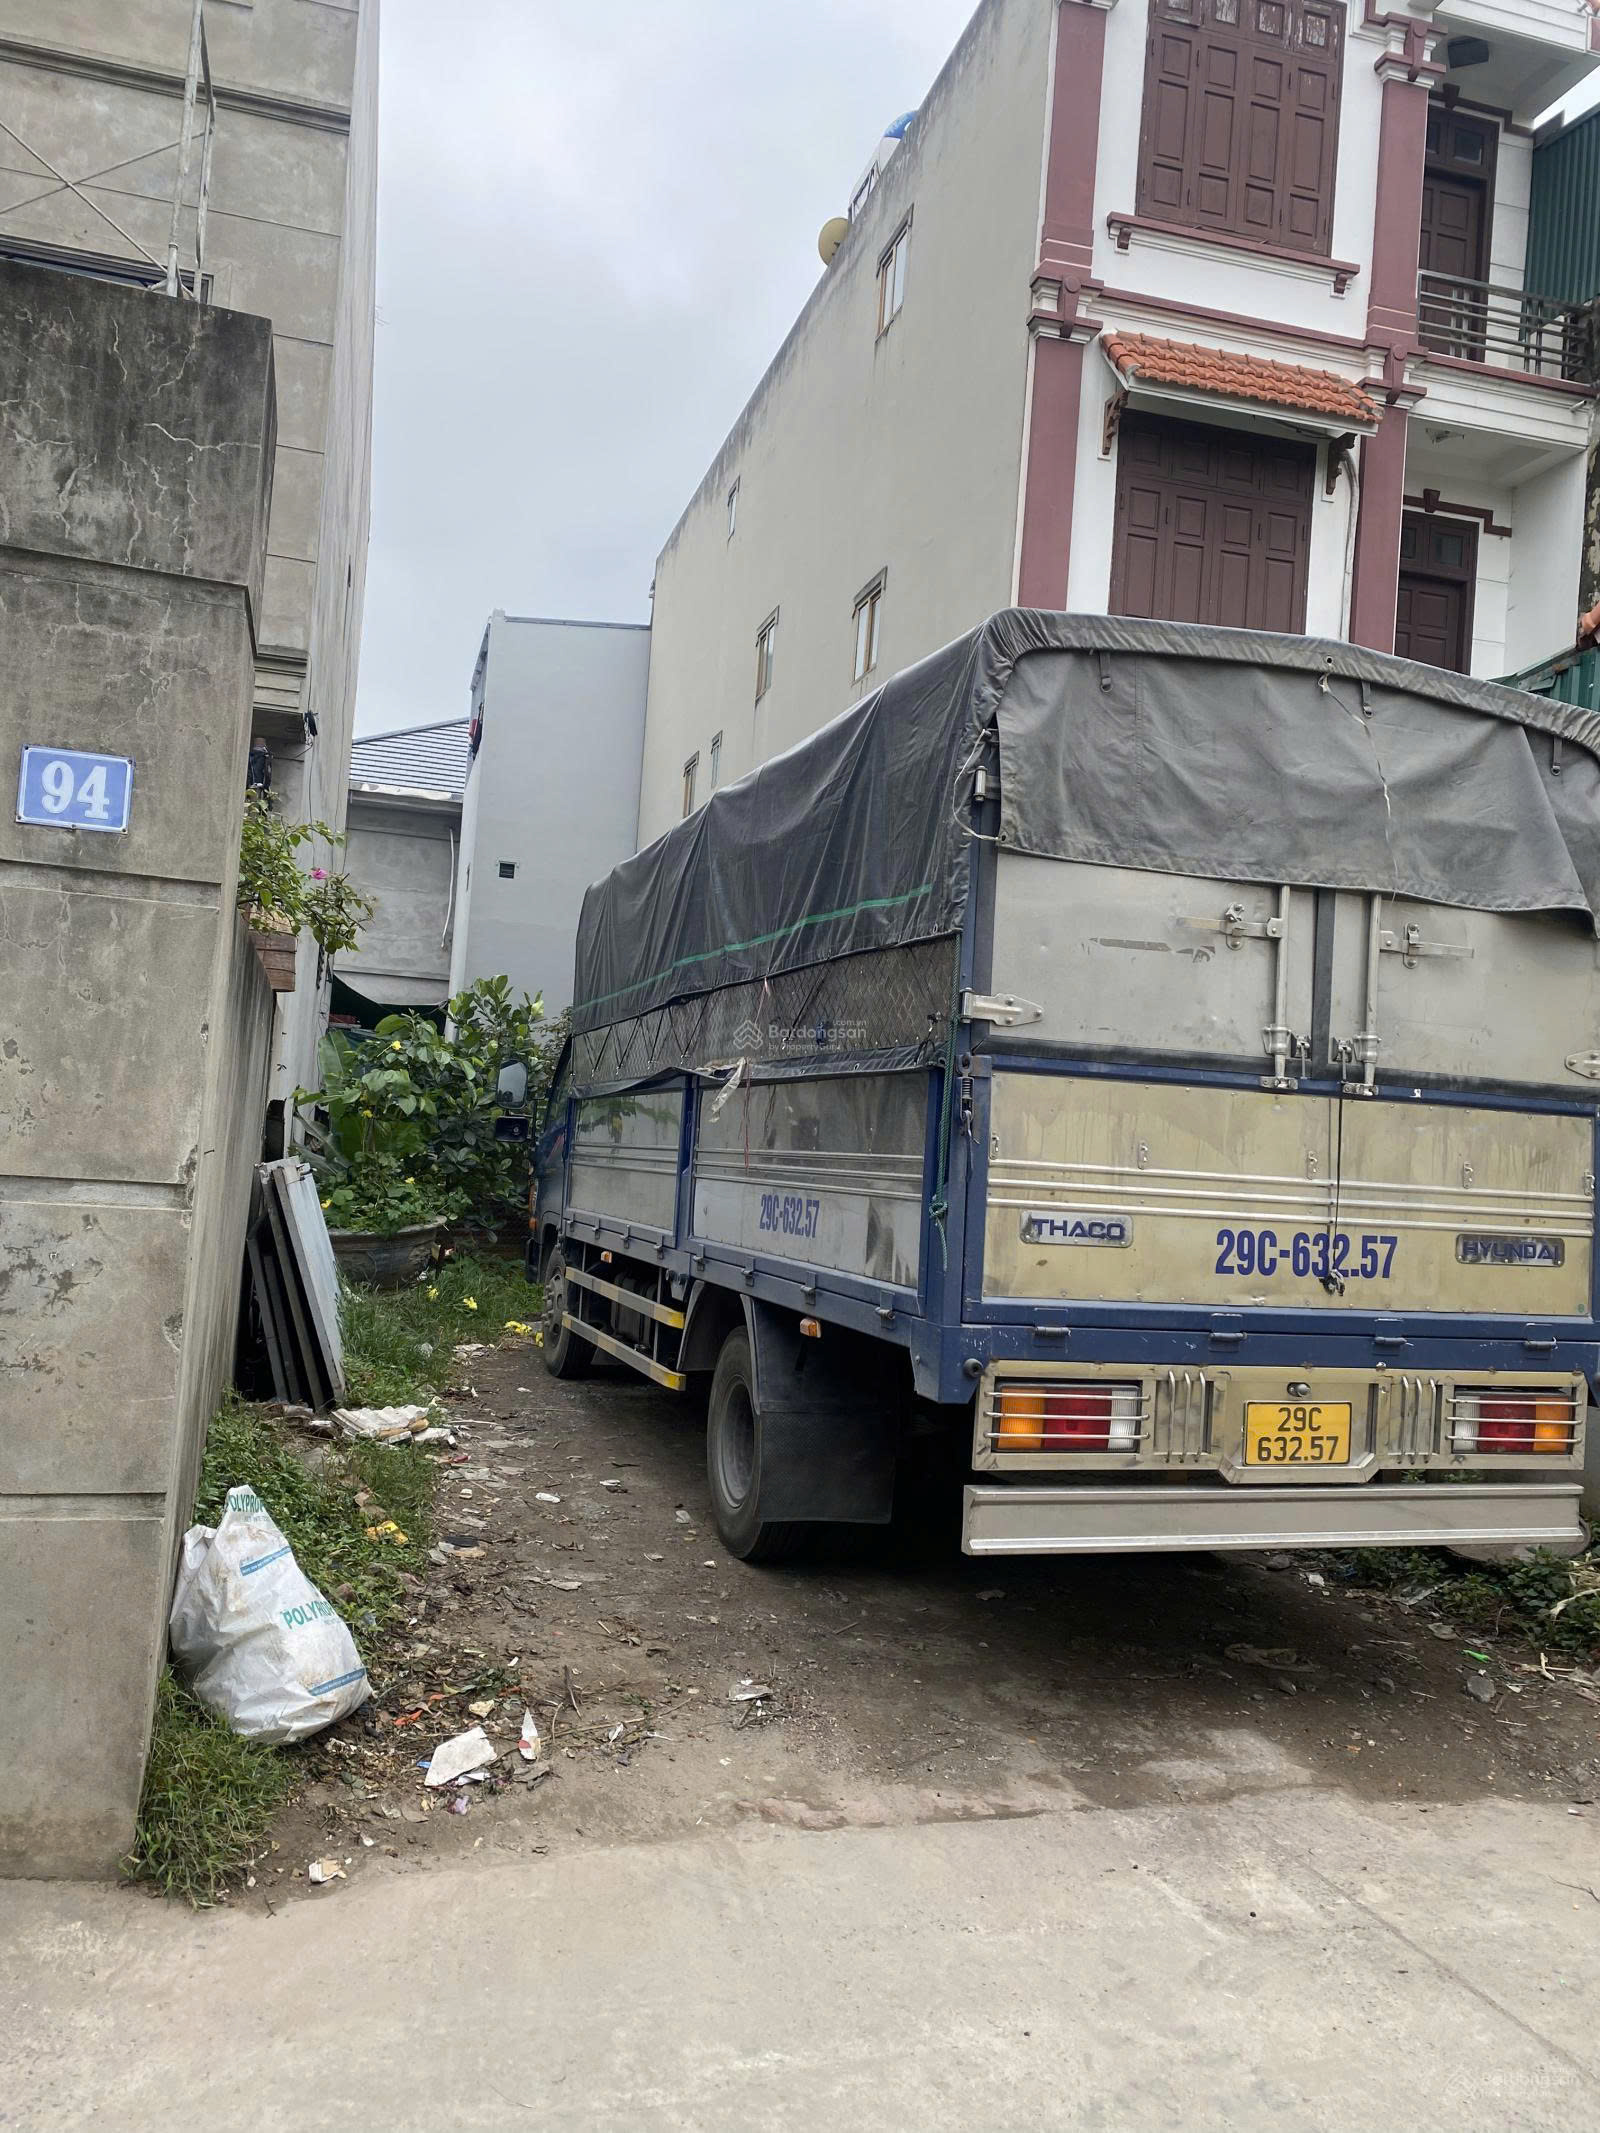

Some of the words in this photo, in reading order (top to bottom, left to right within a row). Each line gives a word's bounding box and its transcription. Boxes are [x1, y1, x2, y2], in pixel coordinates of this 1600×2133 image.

[41, 760, 110, 820] 94
[760, 1194, 820, 1238] 29C-632.57
[1031, 1217, 1126, 1241] THACO
[1215, 1228, 1398, 1279] 29C-632.57
[1462, 1240, 1560, 1260] HYUNDAI
[1277, 1406, 1322, 1432] 29C
[1257, 1435, 1339, 1462] 632.57
